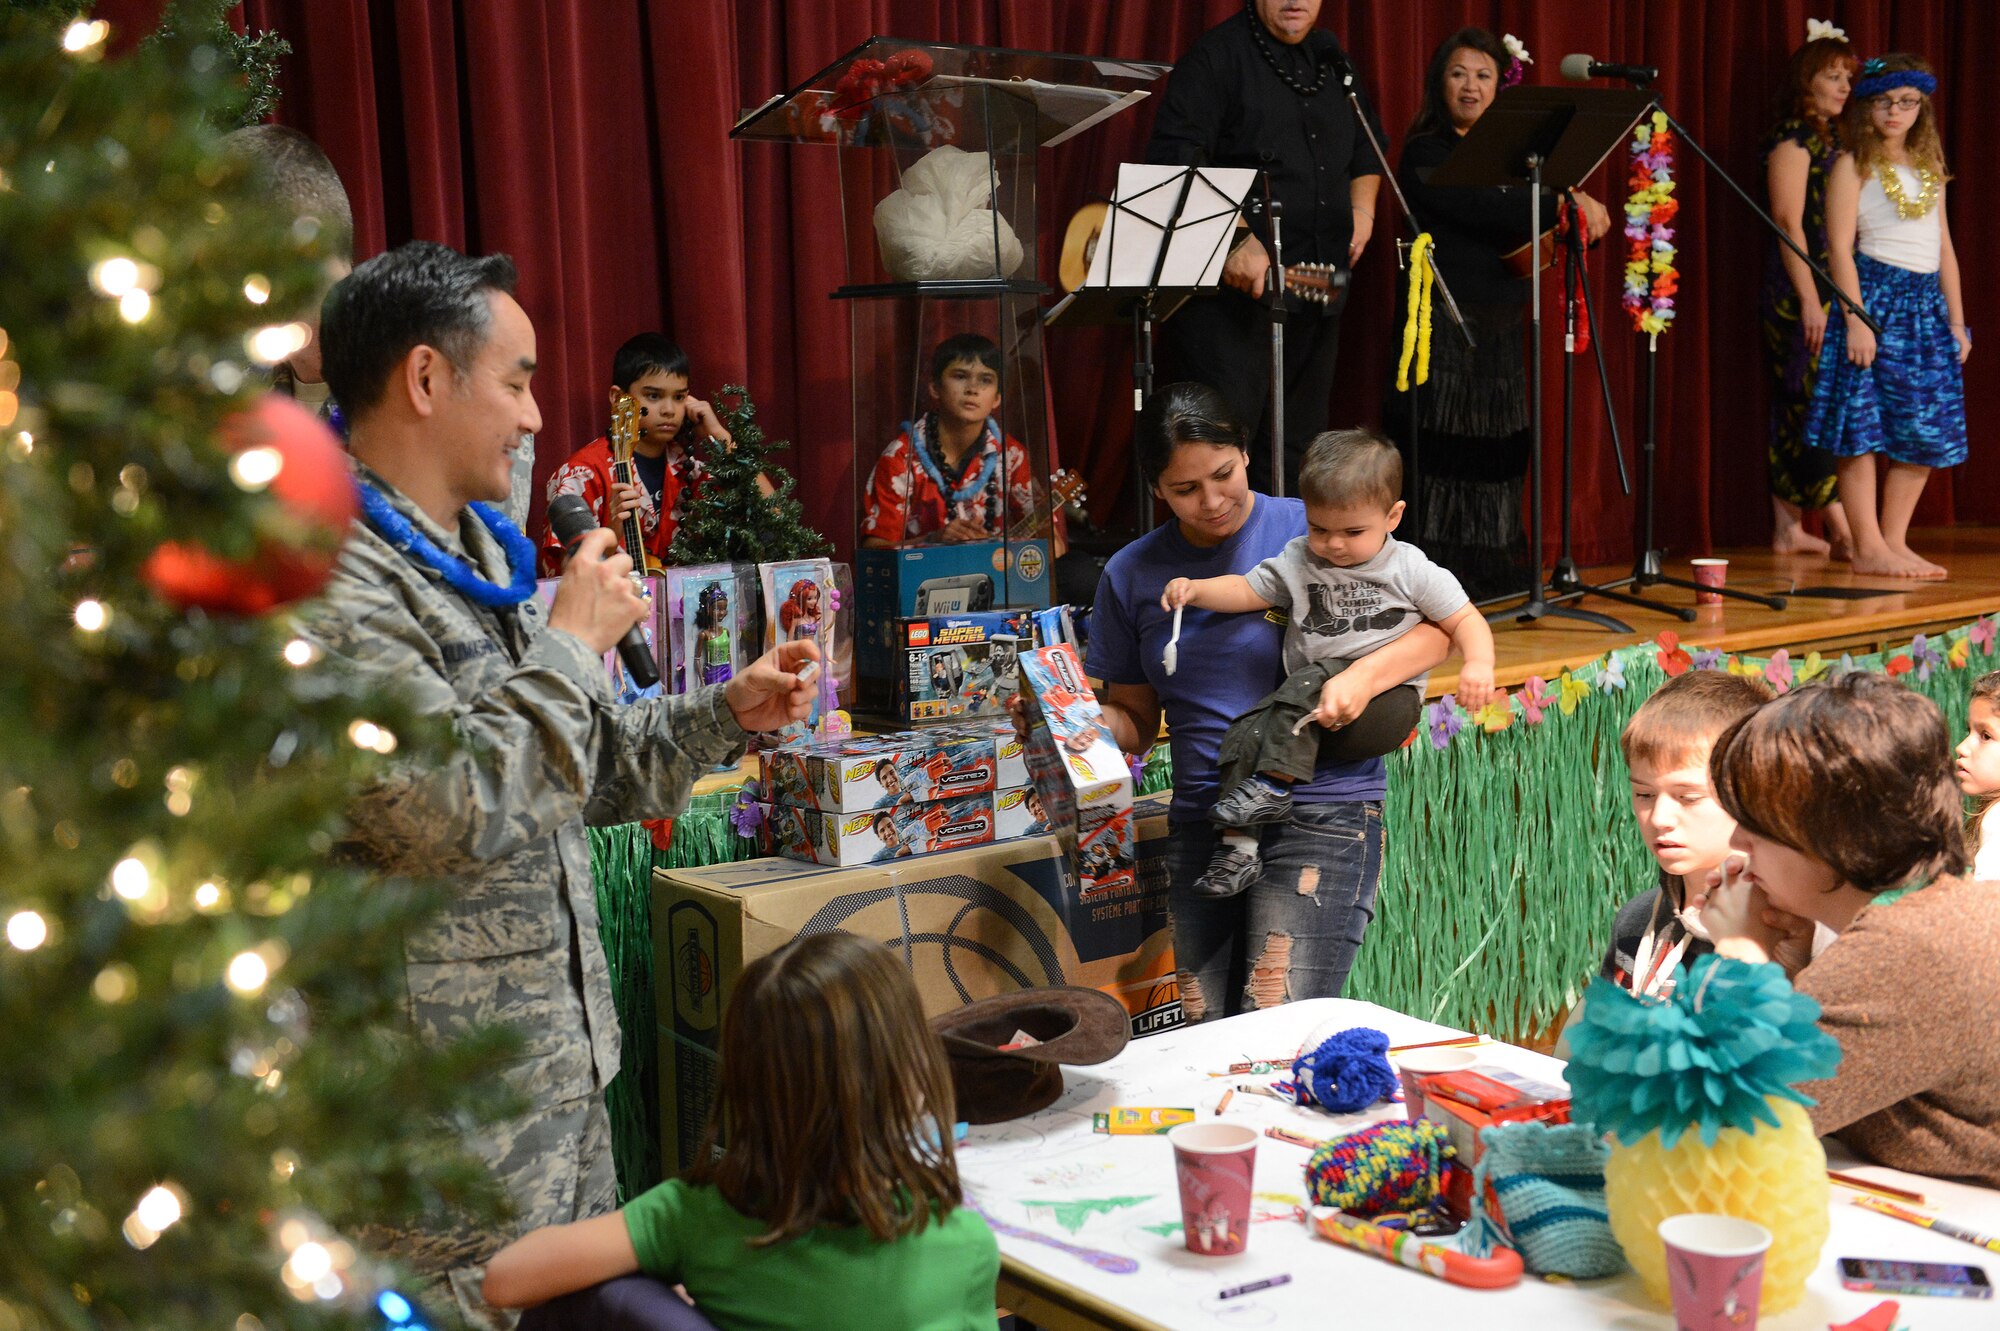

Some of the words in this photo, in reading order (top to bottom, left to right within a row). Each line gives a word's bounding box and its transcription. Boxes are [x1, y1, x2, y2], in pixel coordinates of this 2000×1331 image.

[909, 629, 929, 640] LEGO
[939, 626, 985, 637] SUPER
[932, 634, 986, 645] HEROES
[908, 653, 928, 662] 6-12
[844, 760, 877, 783] NERF
[941, 771, 986, 783] VORTEX
[997, 789, 1025, 812] NERF
[842, 813, 875, 837] NERF
[939, 822, 984, 834] VORTEX
[1139, 1007, 1185, 1032] LIFETI
